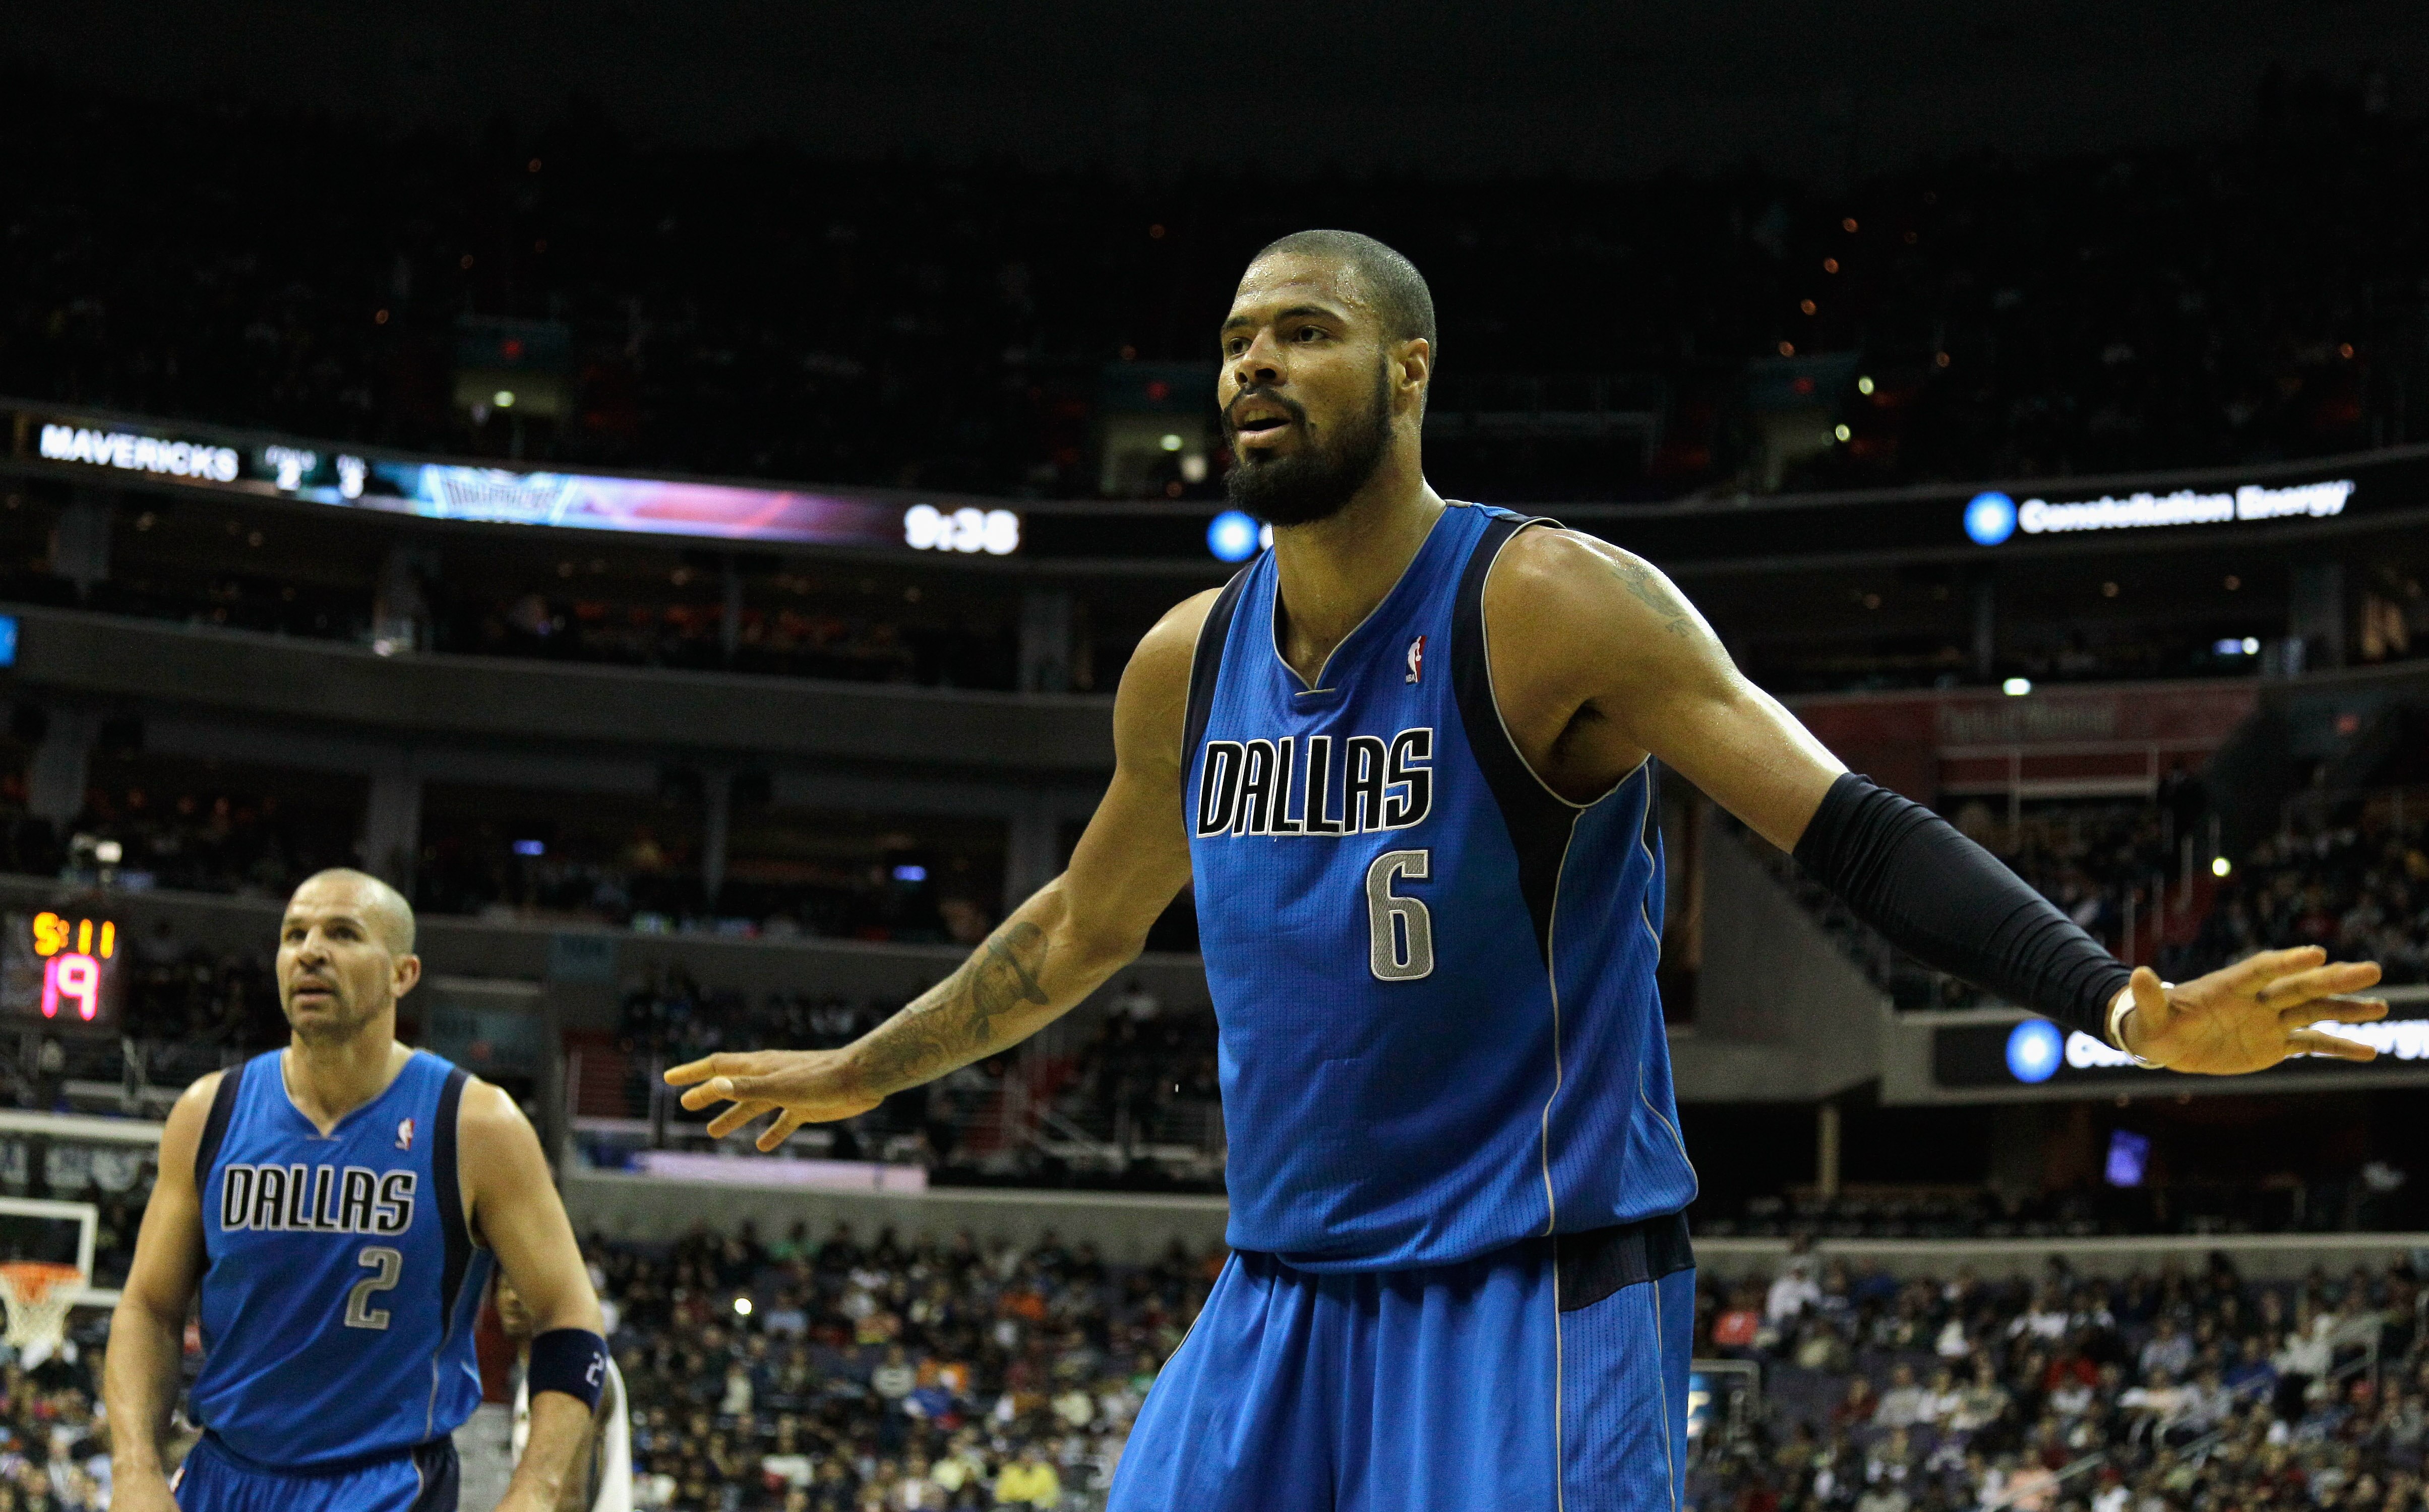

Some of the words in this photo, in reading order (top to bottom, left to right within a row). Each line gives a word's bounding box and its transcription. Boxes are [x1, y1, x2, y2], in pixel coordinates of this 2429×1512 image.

[40, 423, 239, 482] MAVERICKS
[1197, 727, 1433, 838] DALLAS
[33, 912, 115, 959] 5:11
[1367, 849, 1434, 981] 6
[41, 952, 101, 1021] 19
[221, 1163, 417, 1236] DALLAS
[344, 1245, 402, 1330] 2
[586, 1351, 605, 1387] 2
